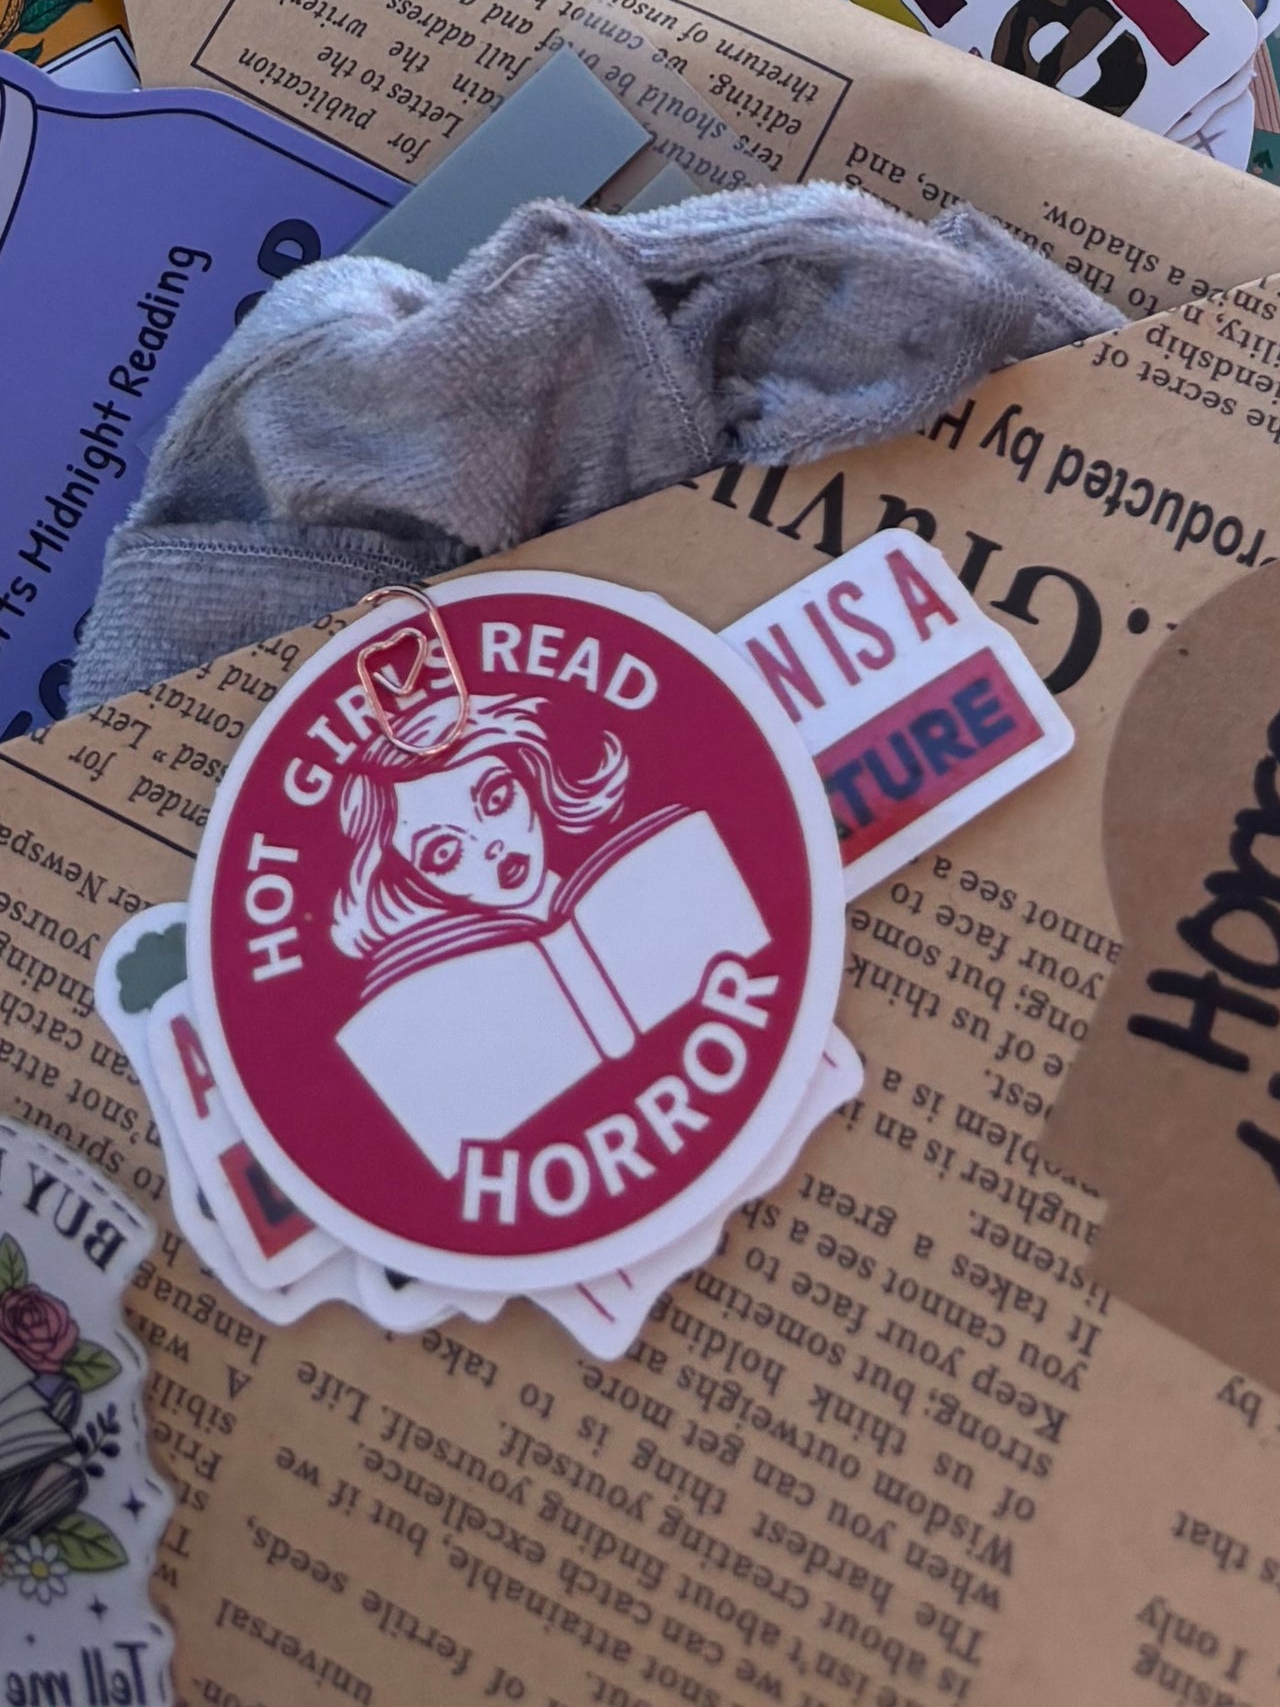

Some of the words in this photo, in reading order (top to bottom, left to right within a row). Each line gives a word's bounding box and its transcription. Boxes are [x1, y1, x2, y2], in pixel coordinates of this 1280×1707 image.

[480, 1, 535, 35] and
[557, 0, 645, 51] cannot
[677, 22, 709, 47] of
[317, 45, 358, 76] the
[360, 68, 386, 91] to
[388, 39, 431, 75] the
[476, 42, 533, 82] full
[605, 66, 636, 91] be
[651, 47, 689, 76] we
[238, 47, 377, 131] publication
[636, 85, 727, 139] should
[708, 71, 803, 137] editing.
[388, 131, 432, 165] for
[1041, 197, 1161, 274] shadow.
[1091, 340, 1129, 369] of
[18, 398, 138, 575] Midnight
[108, 243, 214, 398] Reading
[1136, 359, 1237, 417] secret
[981, 416, 1042, 478] by
[805, 577, 896, 688] IS
[885, 548, 962, 643] A
[243, 831, 305, 983] HOT
[481, 622, 660, 712] READ
[459, 956, 782, 1225] HORROR
[1214, 1379, 1264, 1426] by
[245, 1520, 350, 1589] seeds,
[359, 1590, 480, 1678] fertile
